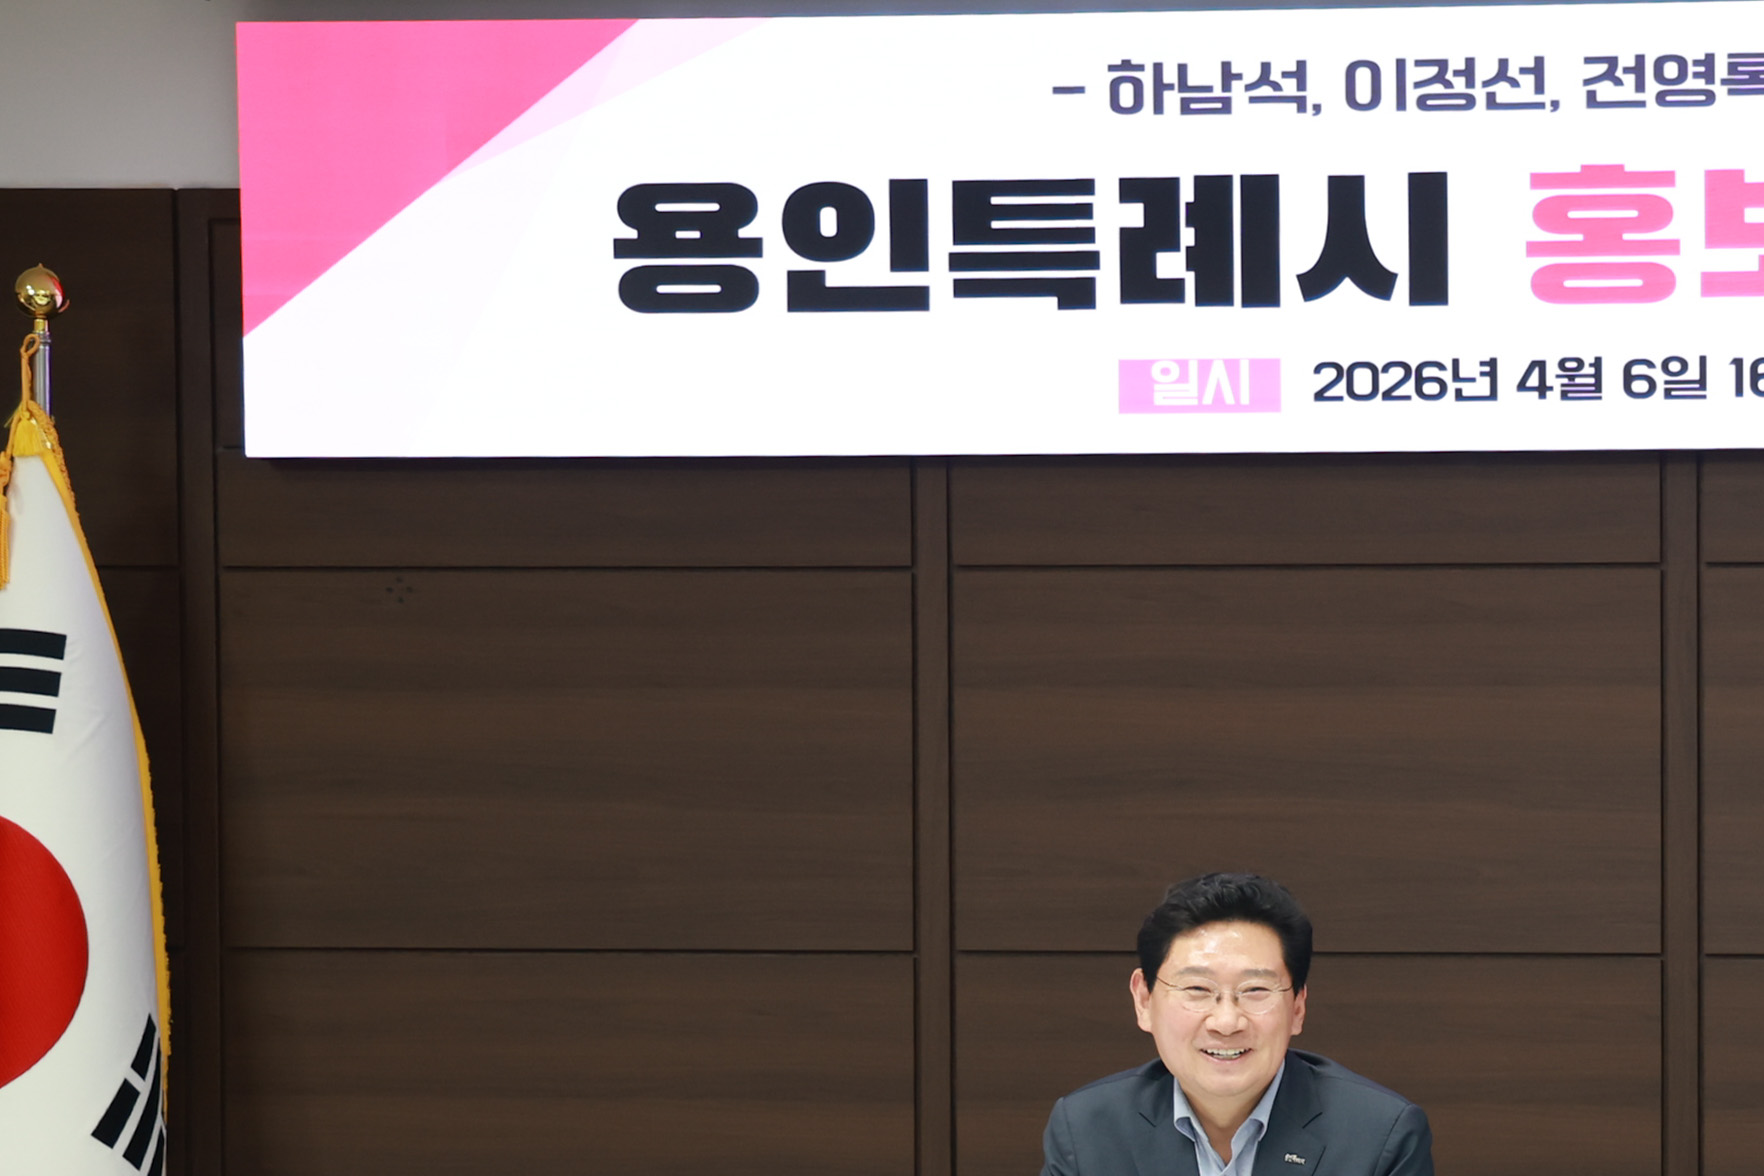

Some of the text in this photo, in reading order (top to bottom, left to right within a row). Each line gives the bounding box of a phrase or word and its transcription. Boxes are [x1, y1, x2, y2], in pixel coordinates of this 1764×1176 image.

[1107, 58, 1322, 117] 하남석,
[1345, 55, 1560, 113] 이정선,
[612, 170, 1450, 315] 용인특례시
[1149, 358, 1250, 406] 일시
[1313, 357, 1498, 402] 2026년
[1516, 356, 1603, 401] 4월
[1622, 355, 1707, 400] 6일
